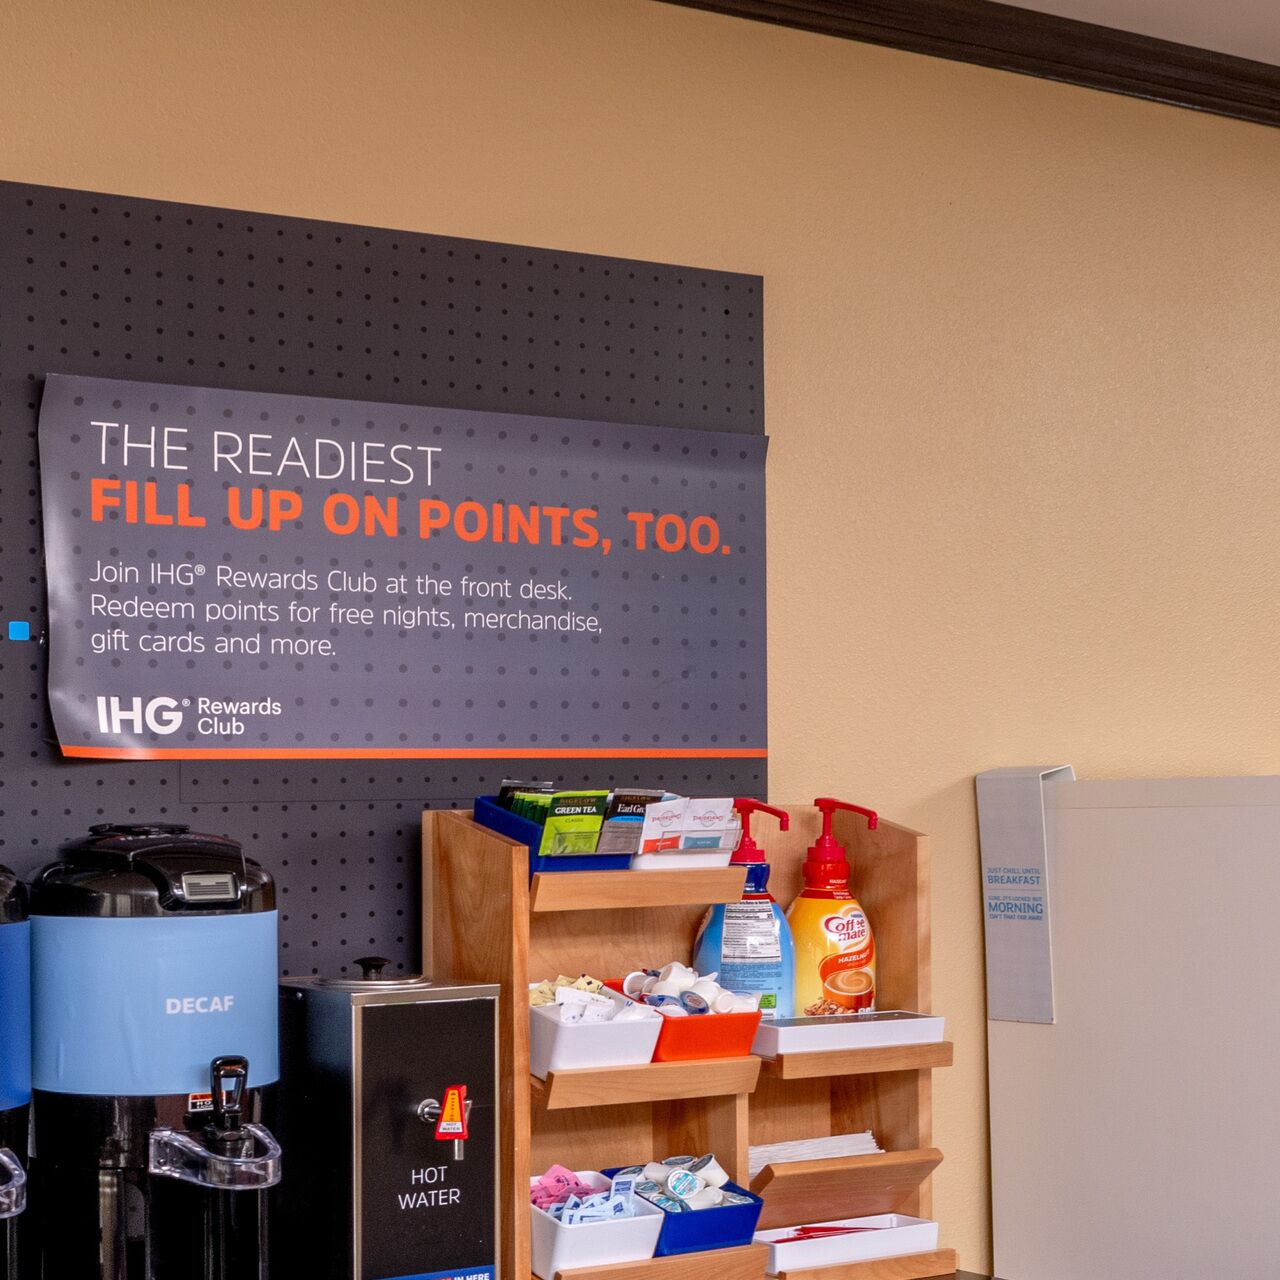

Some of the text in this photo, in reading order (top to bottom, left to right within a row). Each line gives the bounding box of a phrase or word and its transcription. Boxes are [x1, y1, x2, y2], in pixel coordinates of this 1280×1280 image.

[90, 421, 443, 486] THE READIEST
[90, 478, 731, 555] FILL UP ON POINTS, TOO.
[89, 560, 139, 585] Join
[216, 565, 318, 591] Rewards
[327, 570, 377, 593] Club
[386, 575, 408, 594] at
[416, 574, 452, 596] the
[460, 576, 512, 598] front
[520, 579, 572, 600] desk.
[91, 594, 603, 634] Redeem points for free nights, merchandise,
[91, 629, 336, 656] gift cards and more.
[198, 697, 282, 715] Rewards
[198, 717, 245, 736] Club
[554, 806, 581, 814] GREEN
[987, 875, 1041, 885] BREAKFAST
[988, 902, 1043, 914] MORNING
[165, 995, 235, 1015] DECAF
[411, 1166, 448, 1185] HOT
[398, 1188, 460, 1210] WATER
